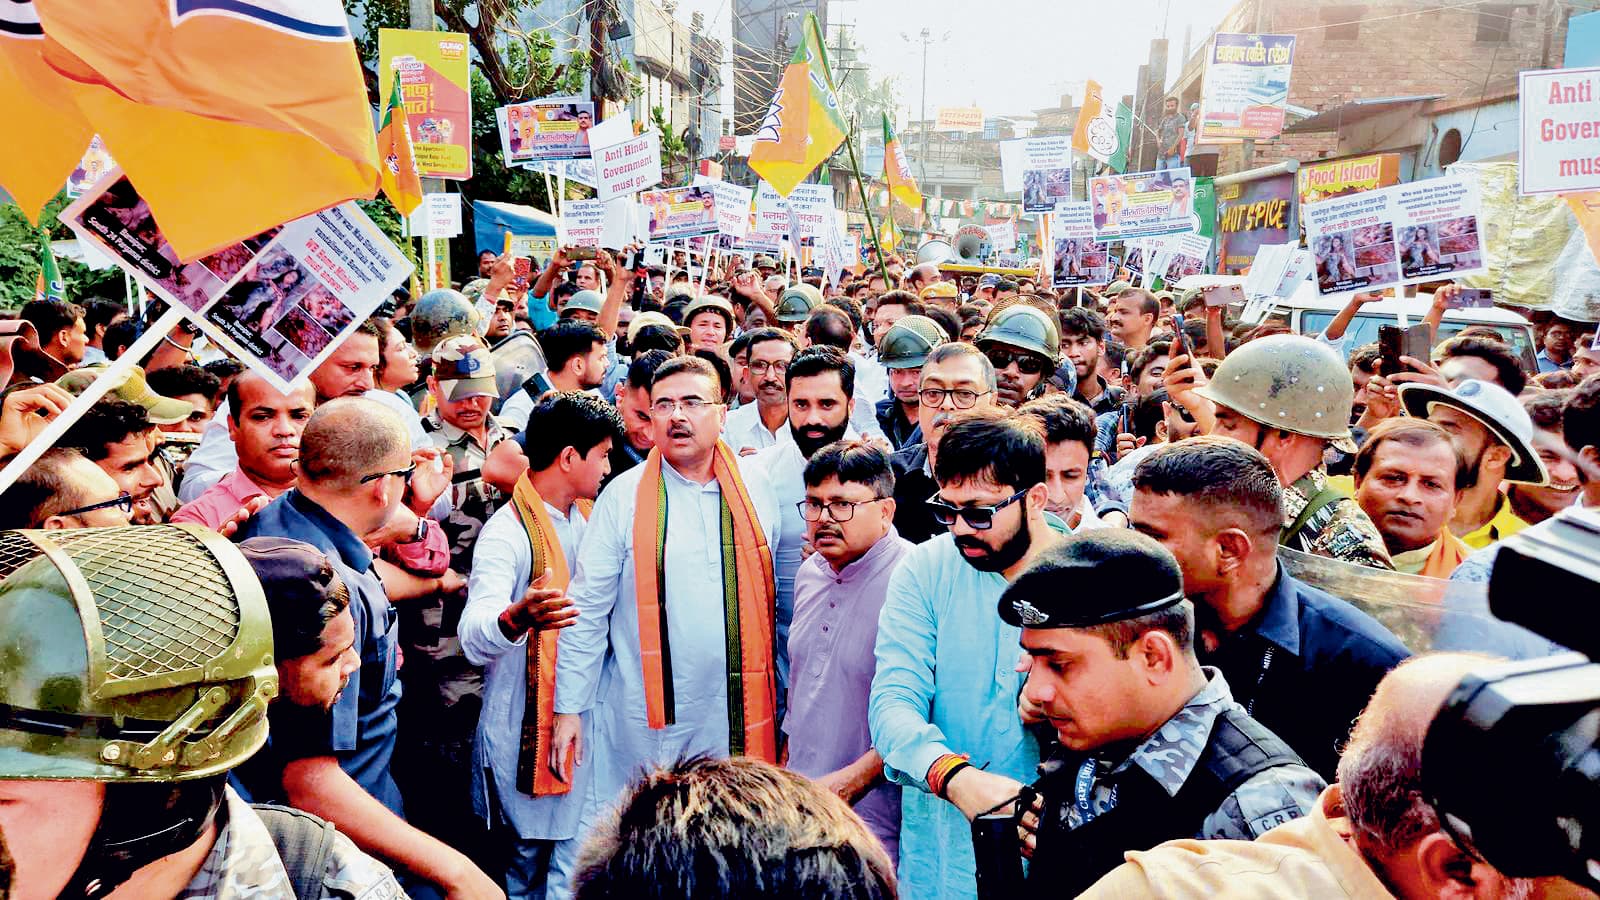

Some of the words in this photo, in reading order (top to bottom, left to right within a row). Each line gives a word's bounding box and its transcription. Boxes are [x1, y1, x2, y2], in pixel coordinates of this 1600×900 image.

[1549, 80, 1592, 105] Anti
[605, 147, 623, 162] Anti
[624, 140, 649, 156] Hindu
[603, 155, 652, 179] Government
[1308, 164, 1336, 186] Food
[1340, 160, 1379, 182] Island
[612, 177, 634, 192] must
[88, 216, 109, 235] South
[1221, 206, 1247, 232] HOT
[1246, 199, 1288, 231] SPICE
[1078, 775, 1089, 810] CRPF
